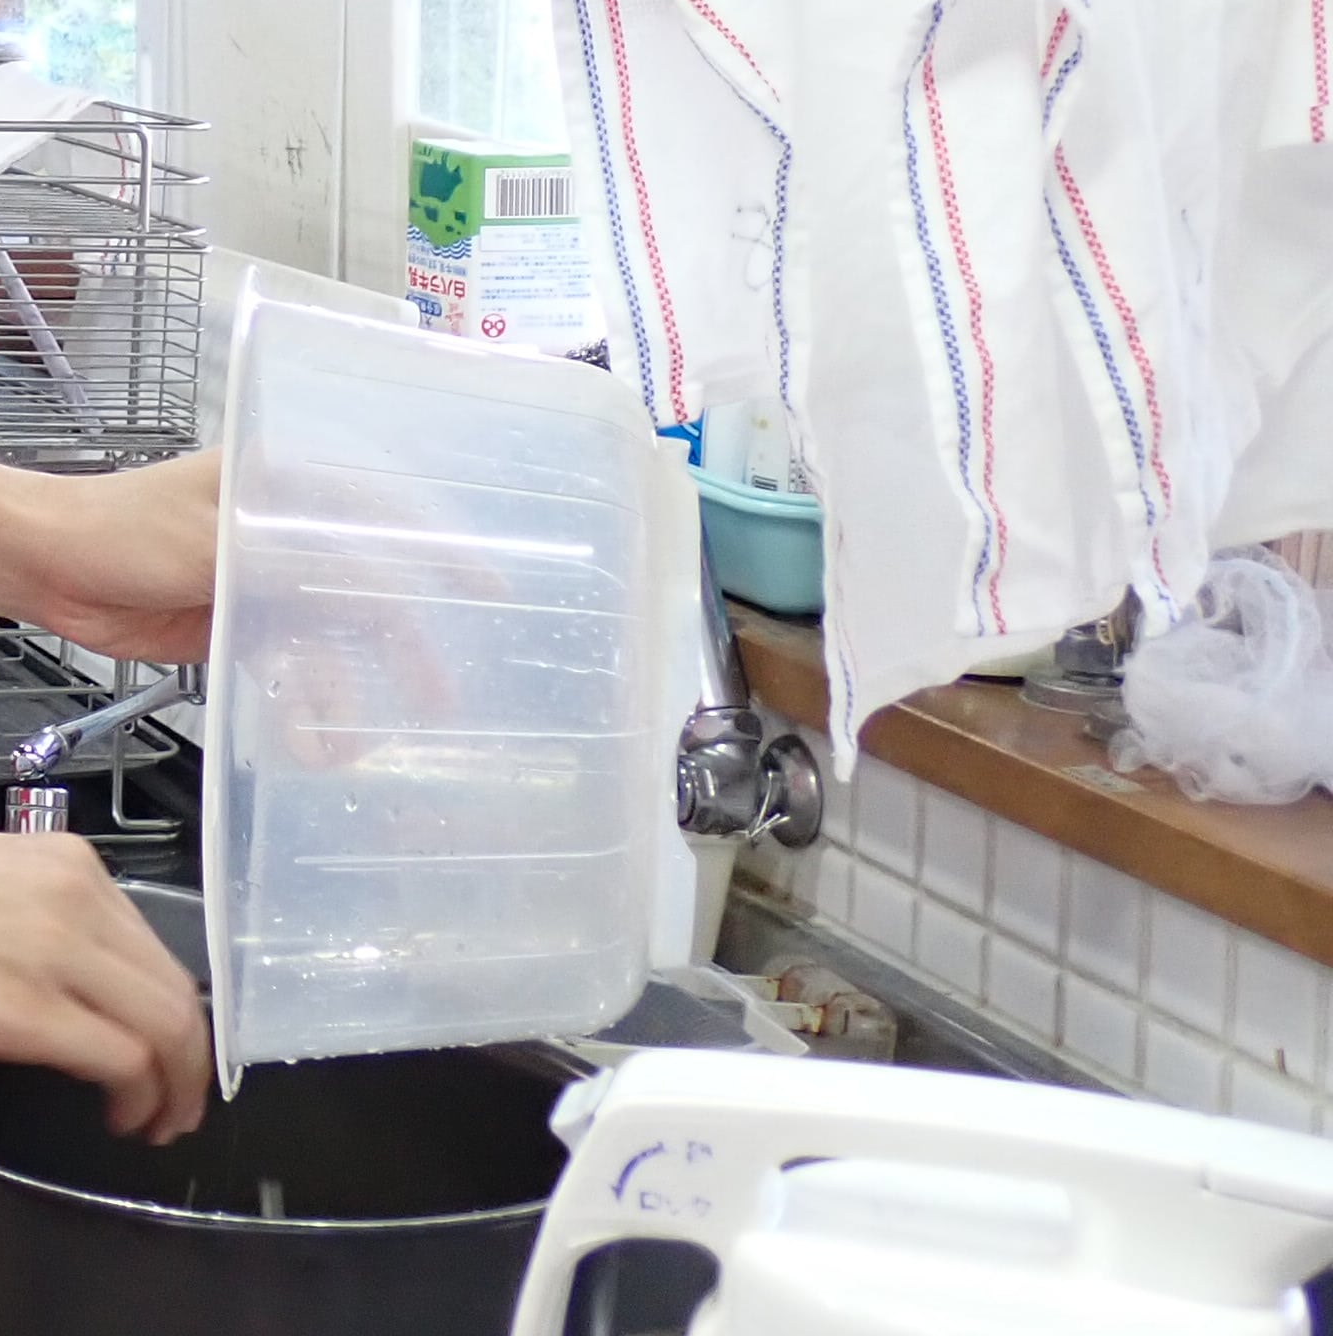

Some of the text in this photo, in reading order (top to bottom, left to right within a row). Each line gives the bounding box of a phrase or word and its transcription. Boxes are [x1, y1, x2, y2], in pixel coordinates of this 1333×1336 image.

[408, 266, 466, 299] 白バラ牛乳
